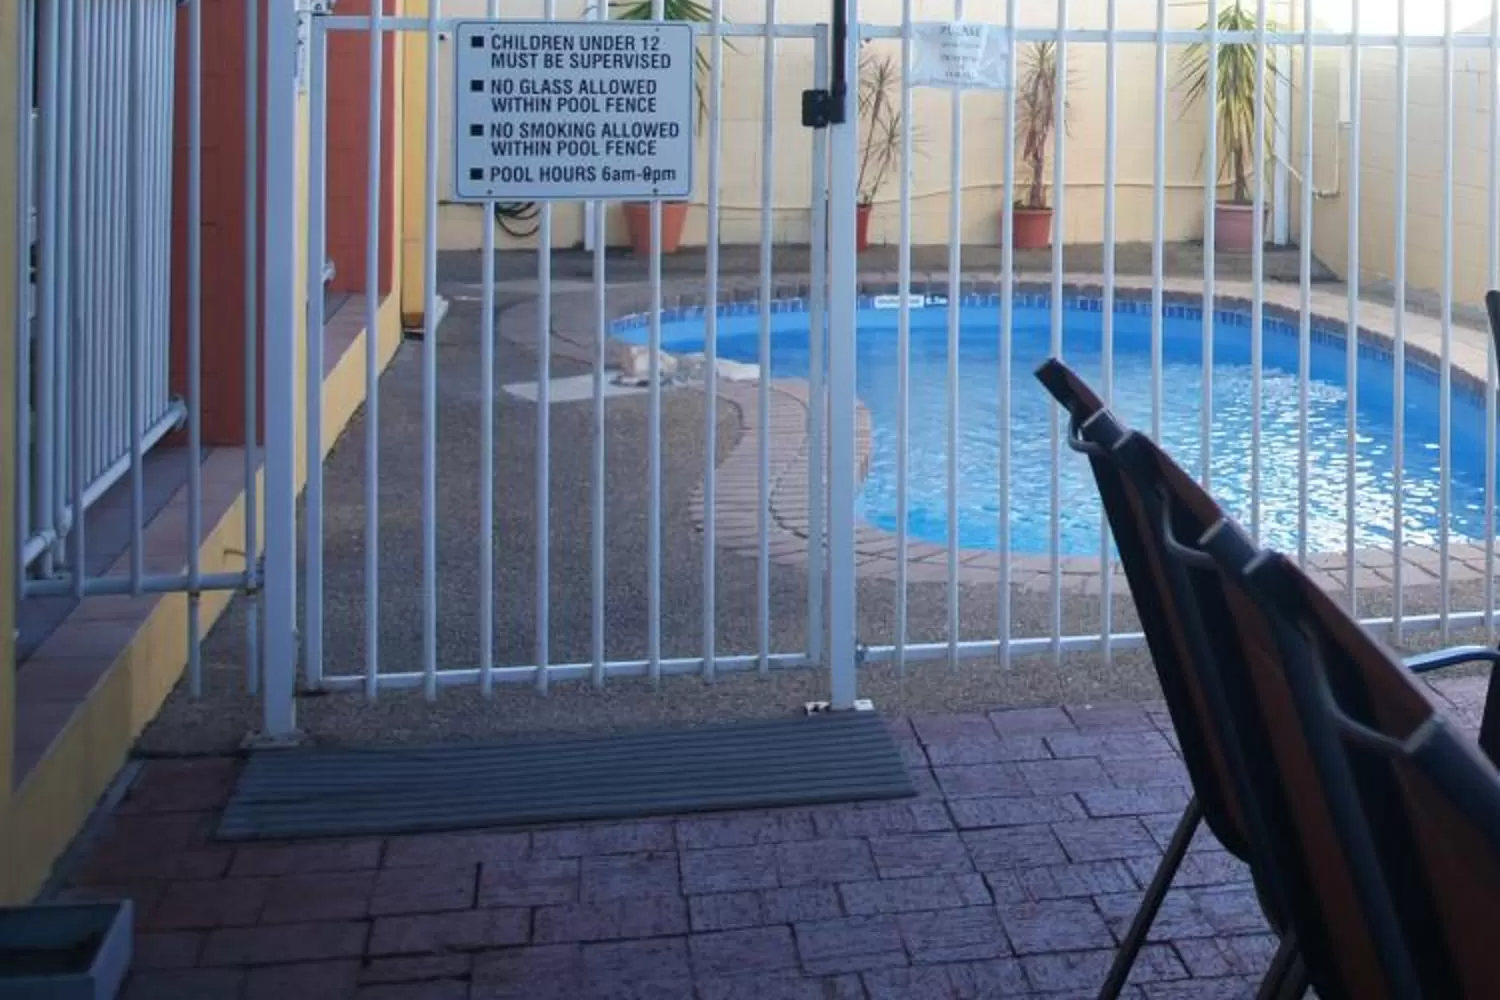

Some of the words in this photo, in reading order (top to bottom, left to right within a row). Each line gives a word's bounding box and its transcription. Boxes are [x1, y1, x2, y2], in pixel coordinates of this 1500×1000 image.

[491, 34, 574, 51] CHILDREN
[580, 36, 635, 51] UNDER
[642, 36, 659, 51] 12
[491, 52, 538, 68] MUST
[544, 53, 564, 68] BE
[570, 53, 671, 69] SUPERVISED
[491, 78, 514, 95] NO
[520, 79, 573, 95] GLASS
[578, 79, 656, 95] ALLOWED
[491, 96, 551, 112] WITHIN
[557, 96, 600, 113] POOL
[606, 97, 656, 112] FENCE
[491, 122, 513, 138] NO
[519, 122, 595, 138] SMOKING
[601, 122, 679, 138] ALLOWED
[491, 140, 551, 156] WITHIN
[557, 140, 600, 156] POOL
[606, 140, 656, 156] FENCE
[490, 166, 534, 183] POOL
[540, 166, 596, 182] HOURS
